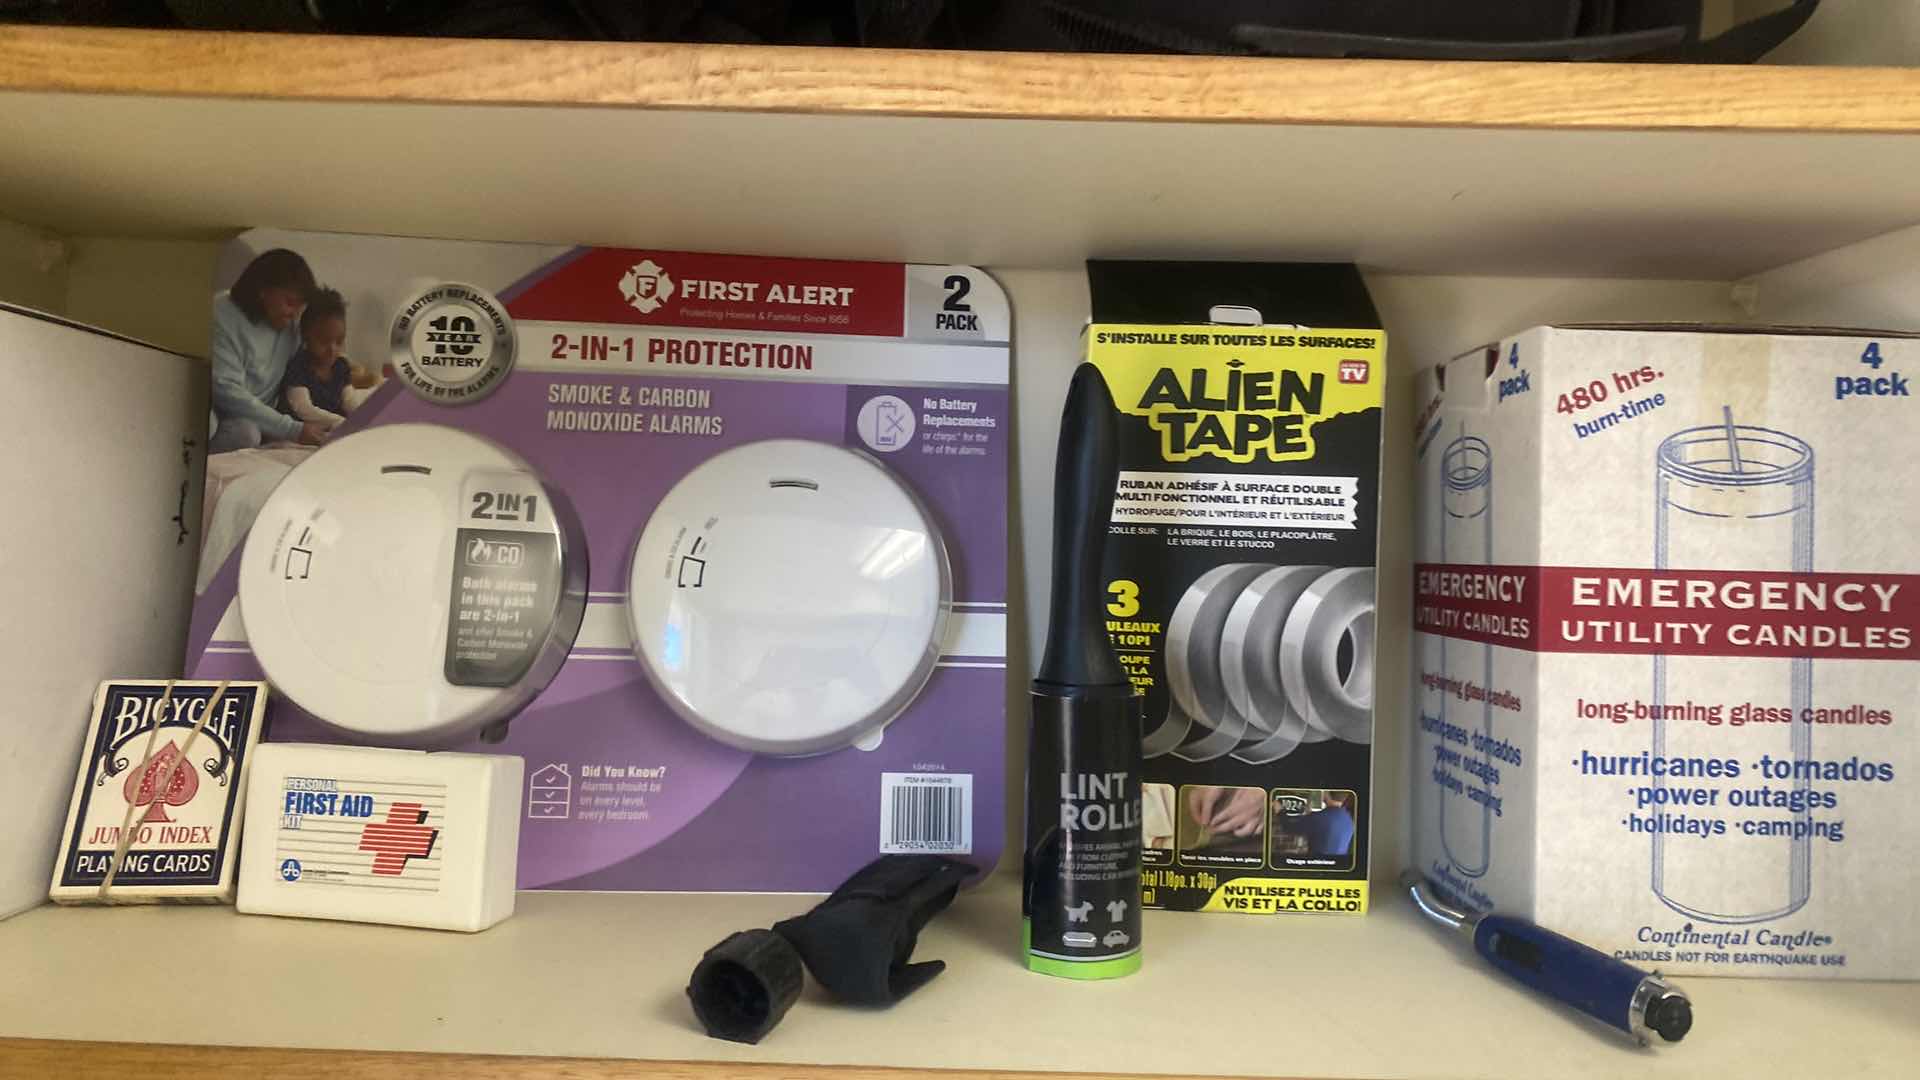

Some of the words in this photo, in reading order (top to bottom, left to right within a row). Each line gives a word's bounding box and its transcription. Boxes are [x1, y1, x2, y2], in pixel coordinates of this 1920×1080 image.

[408, 289, 444, 318] BATTERY
[681, 279, 759, 301] FIRST
[766, 284, 854, 306] ALERT
[943, 275, 971, 312] 2
[429, 315, 476, 355] 10
[935, 313, 978, 331] PACK
[431, 332, 474, 343] YEAR
[1096, 332, 1177, 345] S'INSTALLE
[1181, 334, 1209, 345] SUR
[1213, 334, 1267, 347] TOUTES
[1270, 335, 1296, 347] LES
[1299, 337, 1377, 349] SURFACES!
[421, 355, 485, 368] BATTERY
[551, 334, 634, 362] 2-IN-1
[648, 338, 814, 370] PROTECTION
[1509, 342, 1519, 369] 4
[1860, 342, 1884, 369] 4
[401, 361, 417, 381] FOR
[414, 377, 433, 393] LIFE
[1341, 368, 1367, 381] TV
[1499, 369, 1531, 404] pack
[1835, 372, 1910, 400] pack
[548, 383, 613, 406] SMOKE
[619, 386, 632, 406] &
[639, 386, 711, 409] CARBON
[1137, 362, 1325, 415] ALIEN
[1557, 380, 1608, 415] 480
[1612, 366, 1665, 393] hrs.
[923, 398, 938, 410] No
[940, 398, 977, 414] Battery
[1573, 393, 1666, 439] burn-time
[547, 409, 644, 433] MONOXIDE
[649, 413, 723, 436] ALARMS
[923, 414, 997, 428] Replacements
[1158, 412, 1308, 455] TAPE
[1119, 480, 1164, 491] RUBAN
[1167, 479, 1219, 492] ADHÉSIF
[1221, 479, 1232, 492] À
[1235, 483, 1290, 494] SURFACE
[1292, 484, 1343, 495] DOUBLE
[1243, 494, 1257, 505] ET
[1260, 493, 1346, 507] RÉUTILISABLE
[471, 491, 495, 520] 2
[497, 493, 521, 512] IN
[523, 495, 538, 522] 1
[1115, 507, 1207, 518] HYDROFUGE/POUR
[1208, 507, 1268, 520] L'INTÉRIEUR
[1270, 510, 1281, 519] ET
[1284, 510, 1346, 521] L'EXTÉRIEUR
[1167, 528, 1180, 537] LA
[1181, 528, 1218, 539] BRIQUE,
[1218, 529, 1230, 538] LE
[1232, 530, 1257, 540] BOIS,
[1257, 530, 1269, 539] LE
[1167, 537, 1179, 546] LE
[1180, 538, 1210, 547] VERRE
[1212, 538, 1223, 547] ET
[1224, 539, 1236, 548] LE
[1237, 540, 1275, 549] STUCCO
[497, 545, 520, 564] CO
[462, 576, 491, 590] Both
[494, 578, 538, 593] alarms
[1419, 571, 1526, 603] EMERGENCY
[1572, 577, 1901, 612] EMERGENCY
[476, 592, 501, 606] this
[503, 594, 535, 609] pack
[1106, 579, 1140, 617] 3
[459, 609, 481, 622] are
[483, 609, 520, 623] 2-in-1
[1416, 605, 1460, 628] UTILITY
[1463, 611, 1530, 639] CANDLES
[1118, 635, 1151, 646] 10PI
[1561, 620, 1712, 645] UTILITY
[1727, 624, 1912, 649] CANDLES
[110, 696, 240, 751] BICYCLE
[1577, 698, 1724, 725] long-burning
[1729, 702, 1793, 726] glass
[1800, 704, 1893, 726] candles
[581, 765, 601, 778] Did
[604, 765, 625, 778] You
[627, 765, 666, 778] Know?
[1462, 752, 1500, 786] outages
[287, 779, 337, 792] PERSONAL
[1060, 772, 1128, 800] LINT
[285, 791, 338, 816] FIRST
[340, 794, 374, 818] AID
[1727, 786, 1838, 812] outages
[159, 826, 213, 844] INDEX
[153, 854, 212, 873] CARDS
[1190, 875, 1196, 888] x
[1224, 886, 1296, 897] N'UTILISEZ
[1299, 888, 1333, 898] PLUS
[1336, 889, 1361, 899] LES
[1224, 897, 1248, 909] VIS
[1252, 898, 1272, 909] ET
[1276, 899, 1298, 911] LA
[1637, 922, 1749, 950] Continental
[1614, 950, 1672, 962] CANDLES
[1675, 951, 1701, 962] NOT
[1704, 952, 1730, 963] FOR
[1733, 953, 1817, 966] EARTHQUAKE
[1820, 955, 1847, 966] USE
